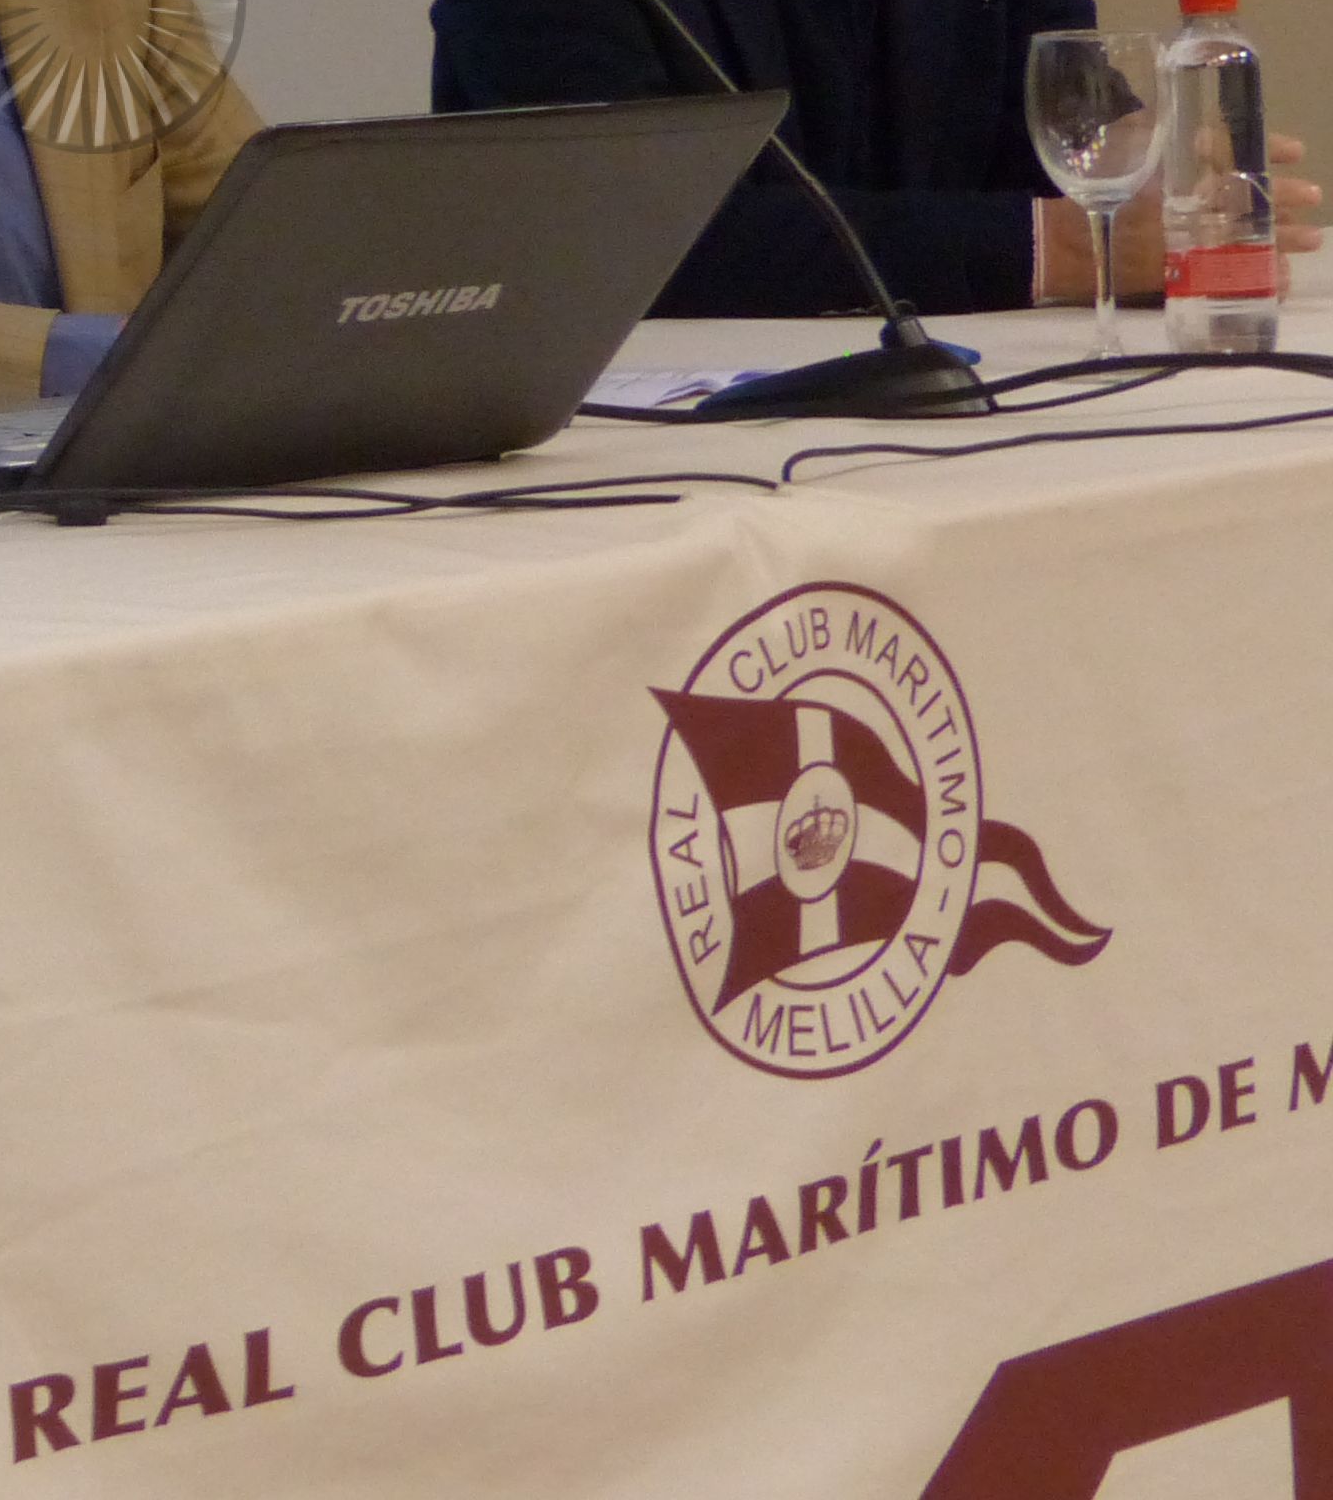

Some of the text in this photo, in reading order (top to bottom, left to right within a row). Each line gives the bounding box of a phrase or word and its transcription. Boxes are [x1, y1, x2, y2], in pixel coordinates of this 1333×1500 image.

[337, 283, 502, 324] TOSHIBA
[728, 607, 831, 695] CLUB
[845, 610, 969, 869] MARITIMO
[665, 792, 721, 965] REAL
[742, 931, 942, 1057] MELILLA
[8, 1326, 295, 1464] REAL
[336, 1246, 601, 1378] CLUB
[640, 1098, 1119, 1302] MARÍTIMO
[1155, 1056, 1256, 1149] DE
